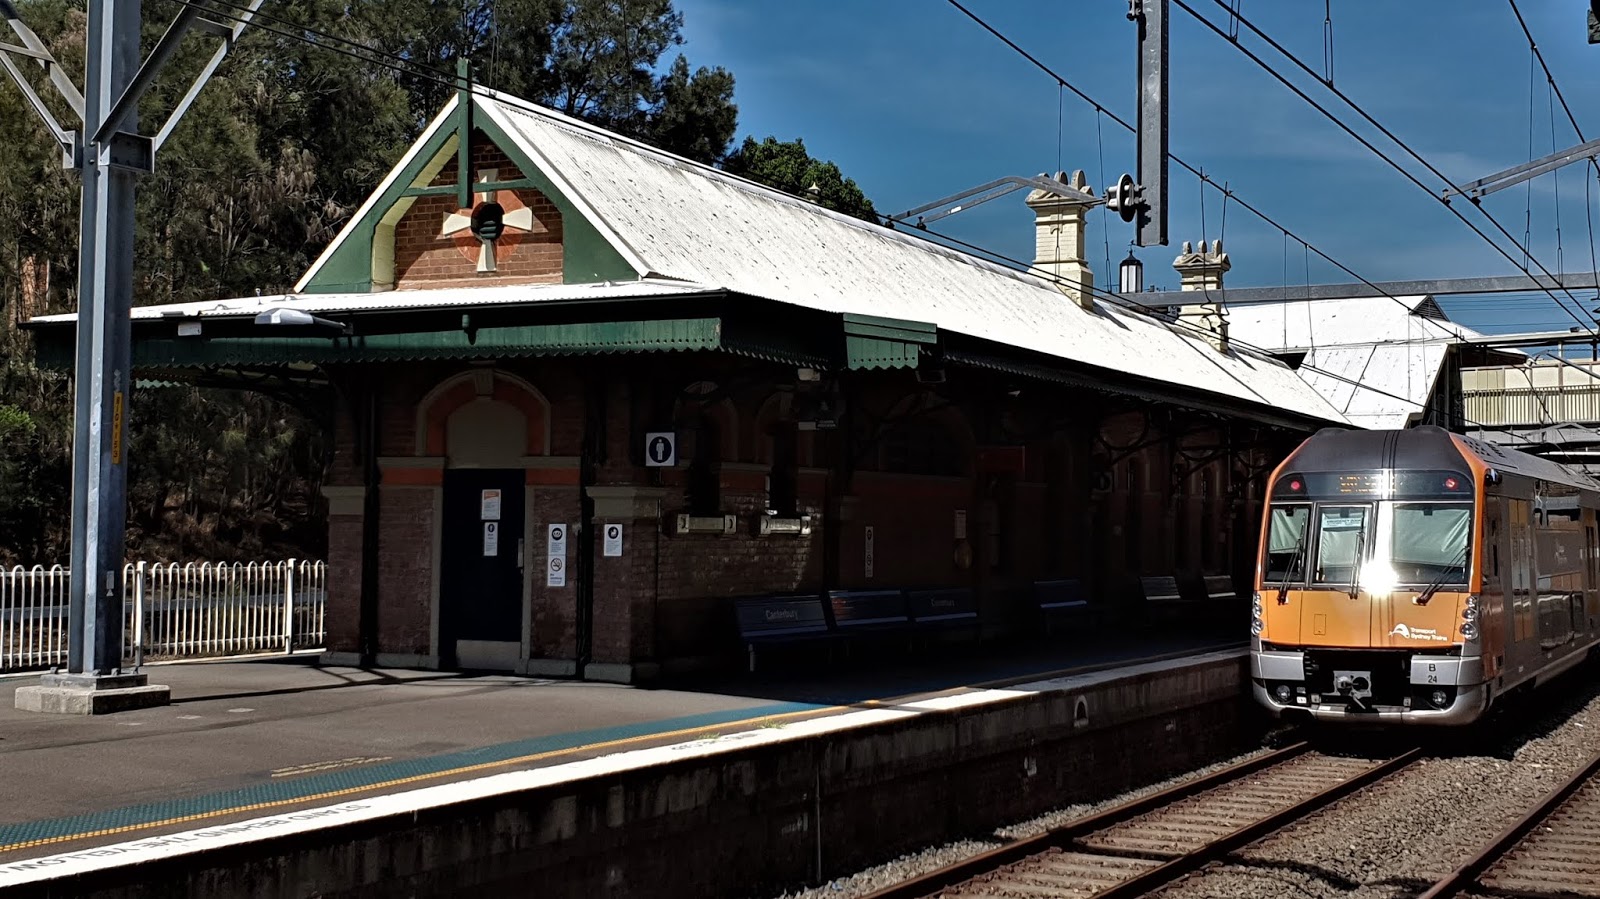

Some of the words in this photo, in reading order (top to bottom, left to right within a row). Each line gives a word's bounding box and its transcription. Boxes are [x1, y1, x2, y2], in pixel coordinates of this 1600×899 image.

[1410, 627, 1436, 635] Transport
[1410, 633, 1431, 641] Sydney
[1428, 663, 1437, 672] B
[1427, 674, 1438, 684] 24
[288, 804, 371, 821] STAND
[194, 818, 289, 838] BEHIND
[132, 834, 198, 849] THE
[7, 847, 140, 872] YELLOW
